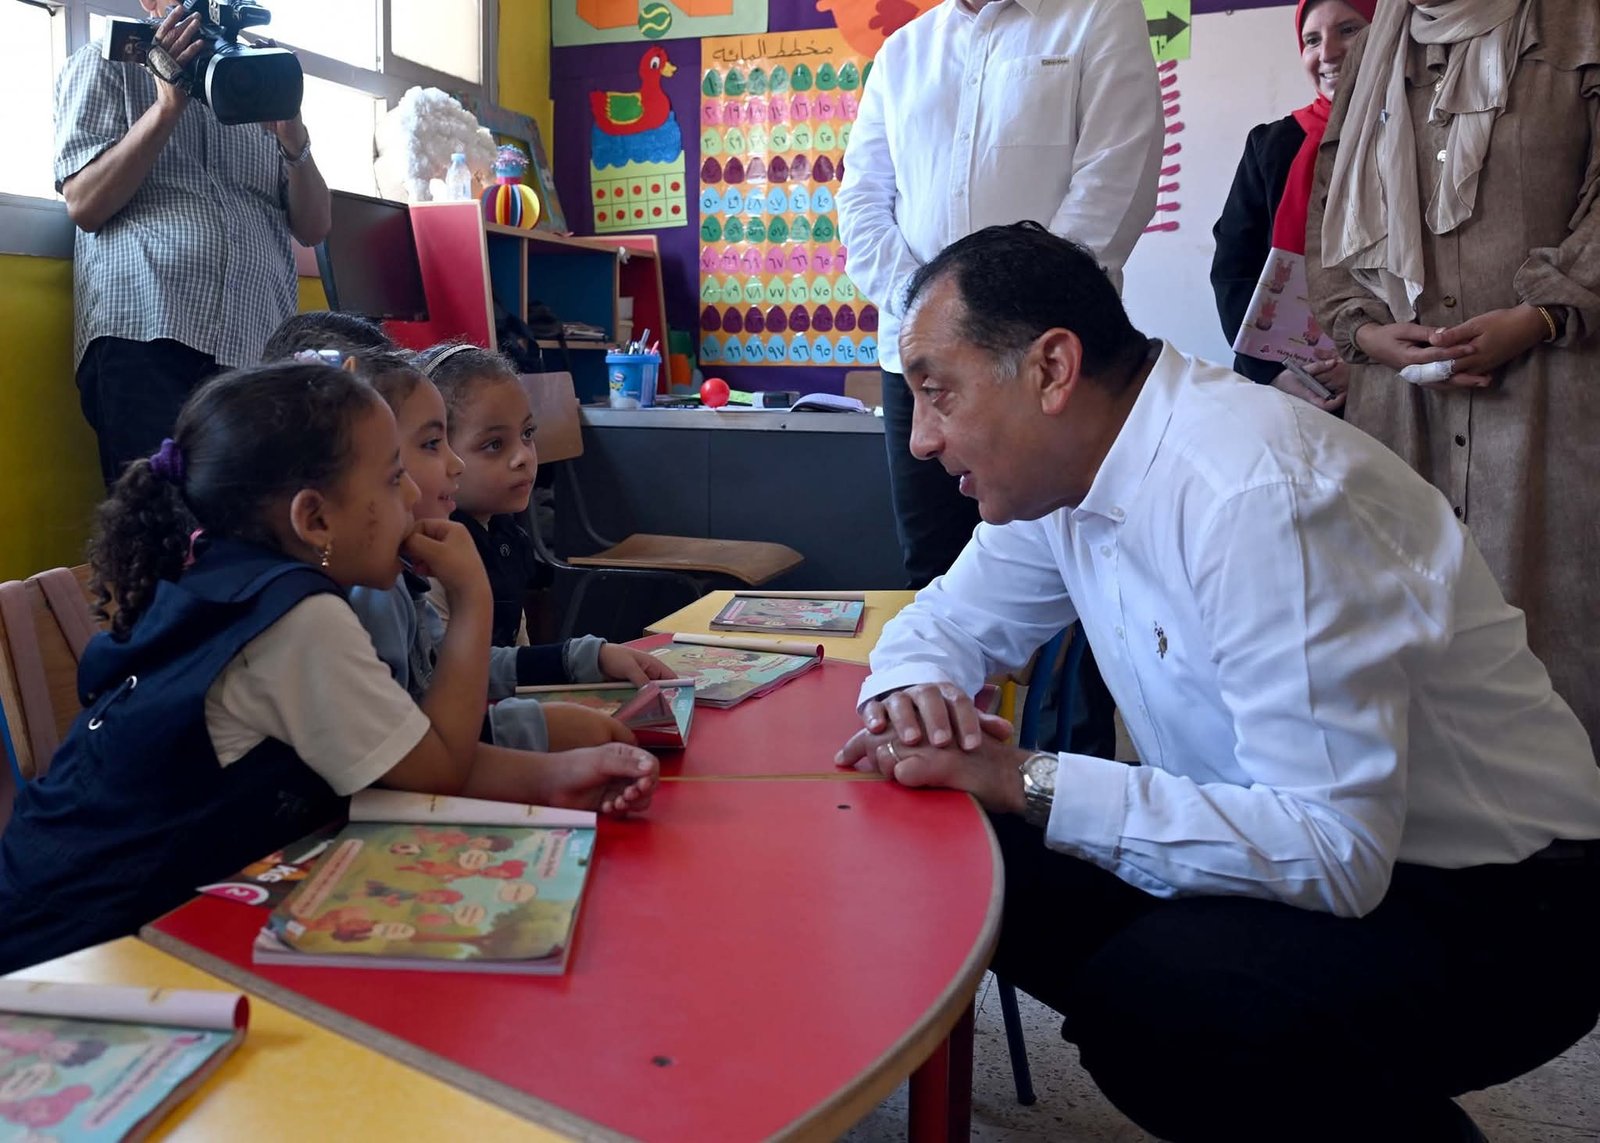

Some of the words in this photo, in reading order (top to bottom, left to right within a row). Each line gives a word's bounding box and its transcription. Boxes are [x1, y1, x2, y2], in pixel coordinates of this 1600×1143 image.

[767, 37, 833, 59] مخطط
[821, 73, 831, 82] ٥
[728, 105, 740, 119] ١٩
[795, 103, 809, 117] ١٦
[818, 101, 831, 115] ١٥
[729, 136, 743, 150] ٢٩
[773, 136, 786, 146] ٢٧
[795, 133, 809, 144] ٢٦
[820, 132, 832, 143] ٢٥
[703, 198, 718, 209] ٥٠
[728, 195, 740, 209] ٤٩
[702, 225, 717, 238] ٦٠
[814, 227, 832, 237] ٥٥
[702, 258, 715, 268] ٧٠
[723, 255, 738, 267] ٦٩
[768, 258, 784, 269] ٦٧
[792, 255, 808, 266] ٦٦
[815, 256, 830, 269] ٦٥
[725, 285, 740, 297] ٧٩
[746, 287, 762, 299] ٧٨
[769, 288, 785, 298] ٧٧
[791, 287, 806, 298] ٧٦
[814, 287, 830, 297] ٧٥
[837, 284, 854, 297] ٧٤
[702, 346, 718, 357] ١٠٠
[727, 346, 741, 358] ٩٩
[745, 345, 763, 358] ٩٨
[768, 345, 785, 359] ٩٧
[793, 345, 810, 359] ٩٦
[815, 344, 831, 358] ٩٥
[837, 345, 855, 360] ٩٤
[860, 346, 877, 359] ٩٣
[256, 864, 299, 883] KG
[224, 887, 250, 897] 2
